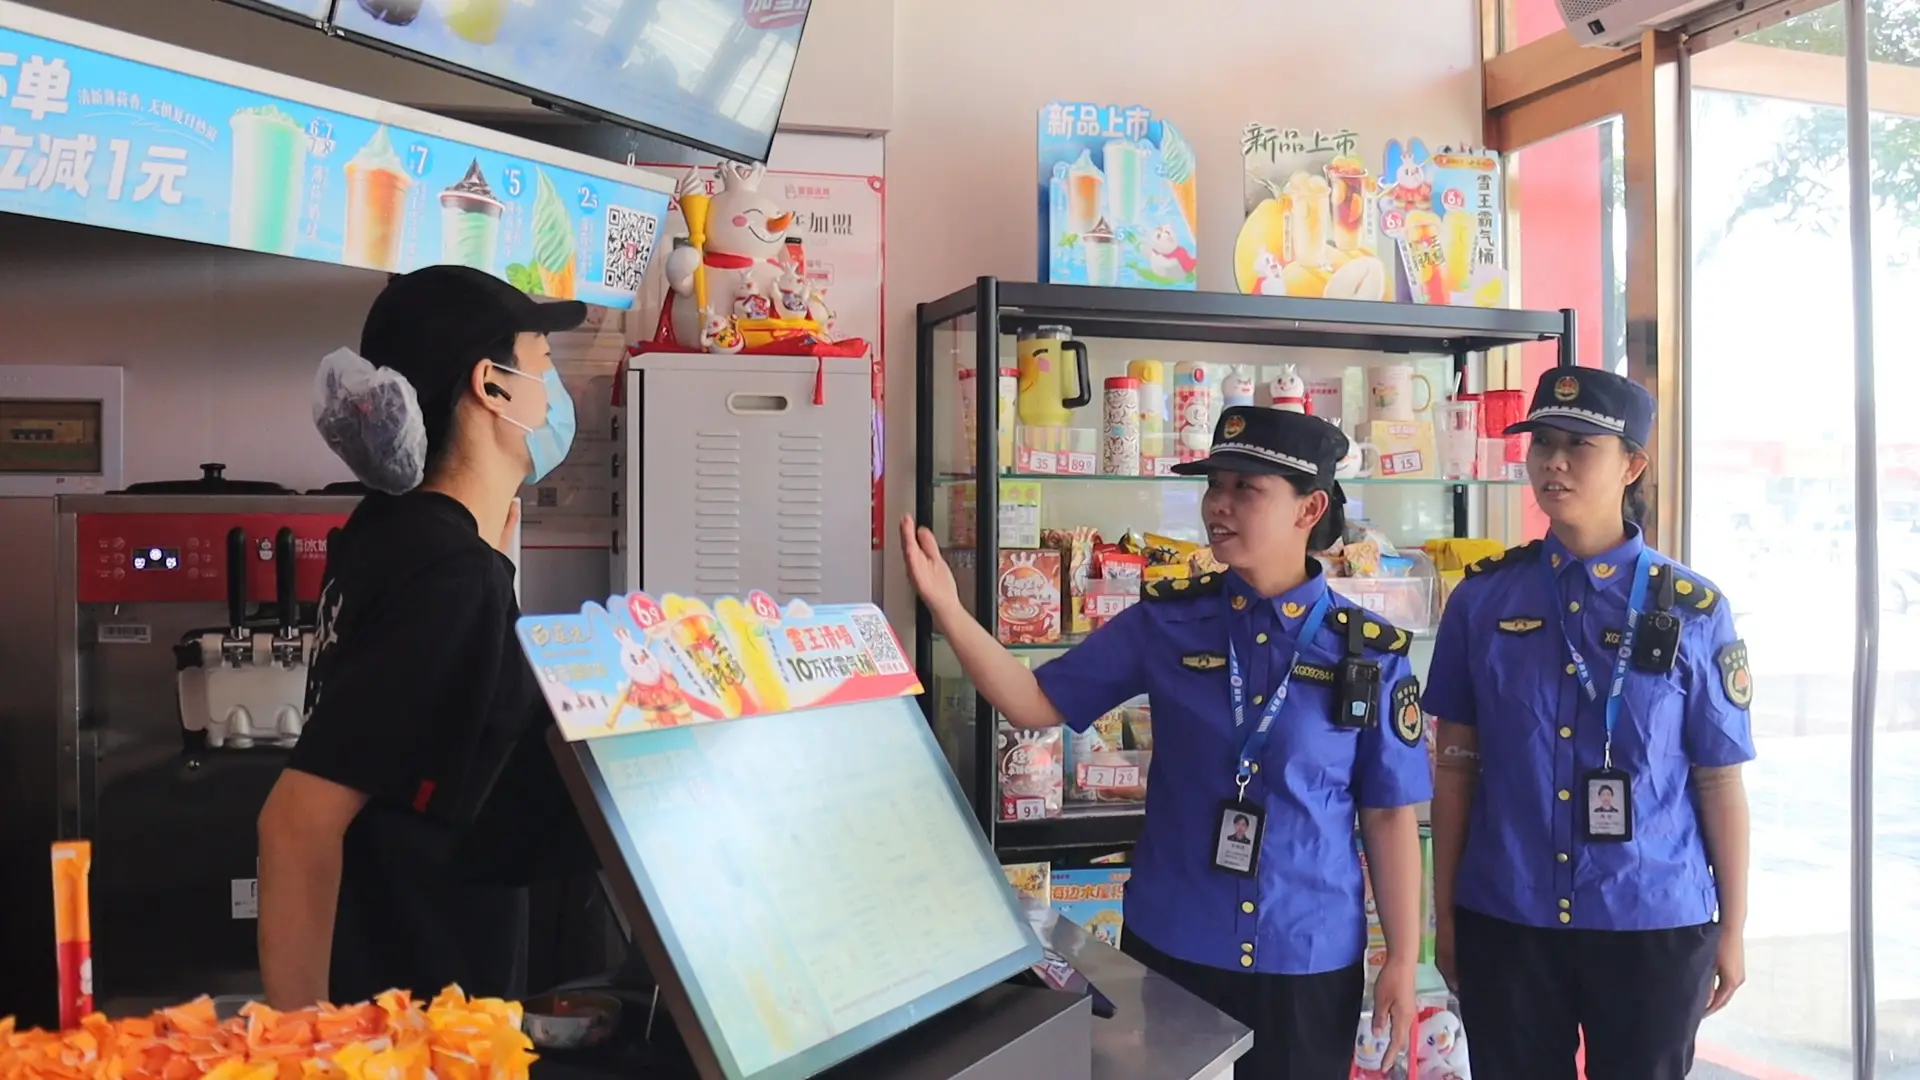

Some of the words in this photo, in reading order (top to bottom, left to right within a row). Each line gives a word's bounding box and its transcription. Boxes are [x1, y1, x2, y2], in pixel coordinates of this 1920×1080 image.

[1047, 104, 1150, 141] 新品上市
[1242, 122, 1359, 164] 新品上市
[1477, 174, 1494, 265] 雪王霸气桶
[1035, 457, 1048, 470] 35
